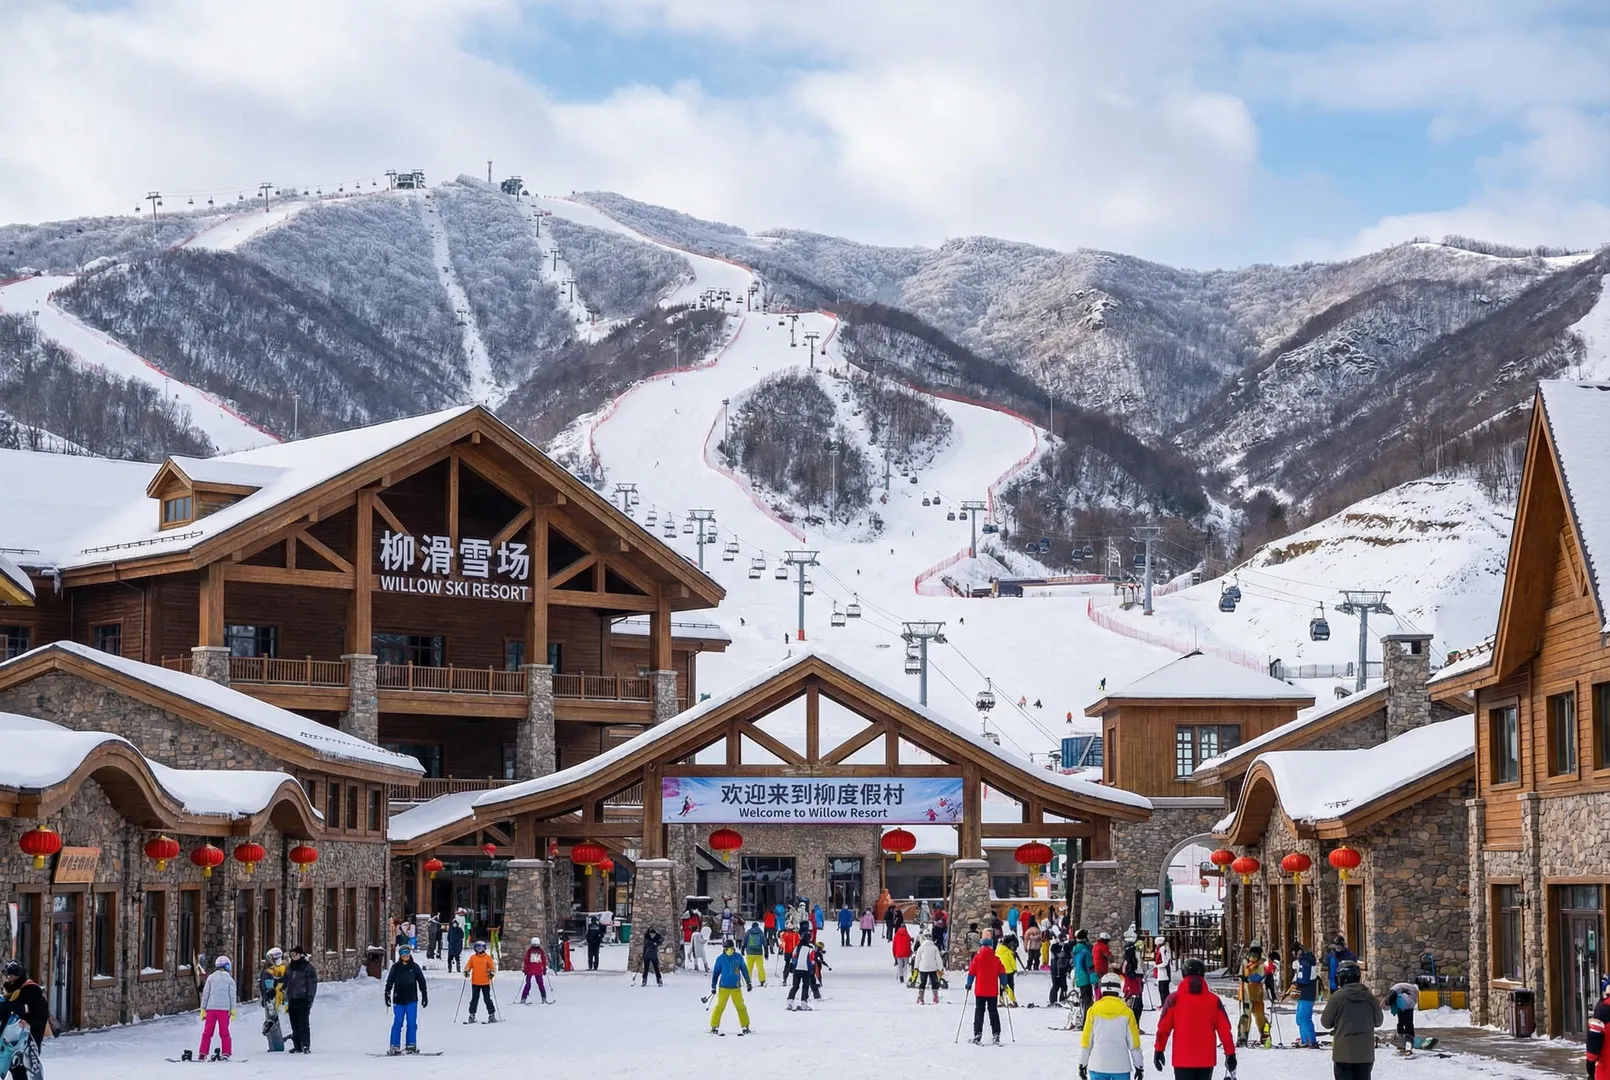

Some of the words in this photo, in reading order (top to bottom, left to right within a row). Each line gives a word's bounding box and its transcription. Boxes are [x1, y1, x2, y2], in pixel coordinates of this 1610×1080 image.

[380, 530, 530, 581] 柳滑雪场
[380, 575, 442, 595] WILLOW
[445, 580, 469, 597] SKI
[472, 583, 529, 601] RESORT
[721, 783, 905, 806] 欢迎来到柳度假村
[739, 807, 791, 819] Welcome
[793, 808, 806, 819] to
[808, 807, 847, 819] Willow
[850, 807, 888, 819] Resort
